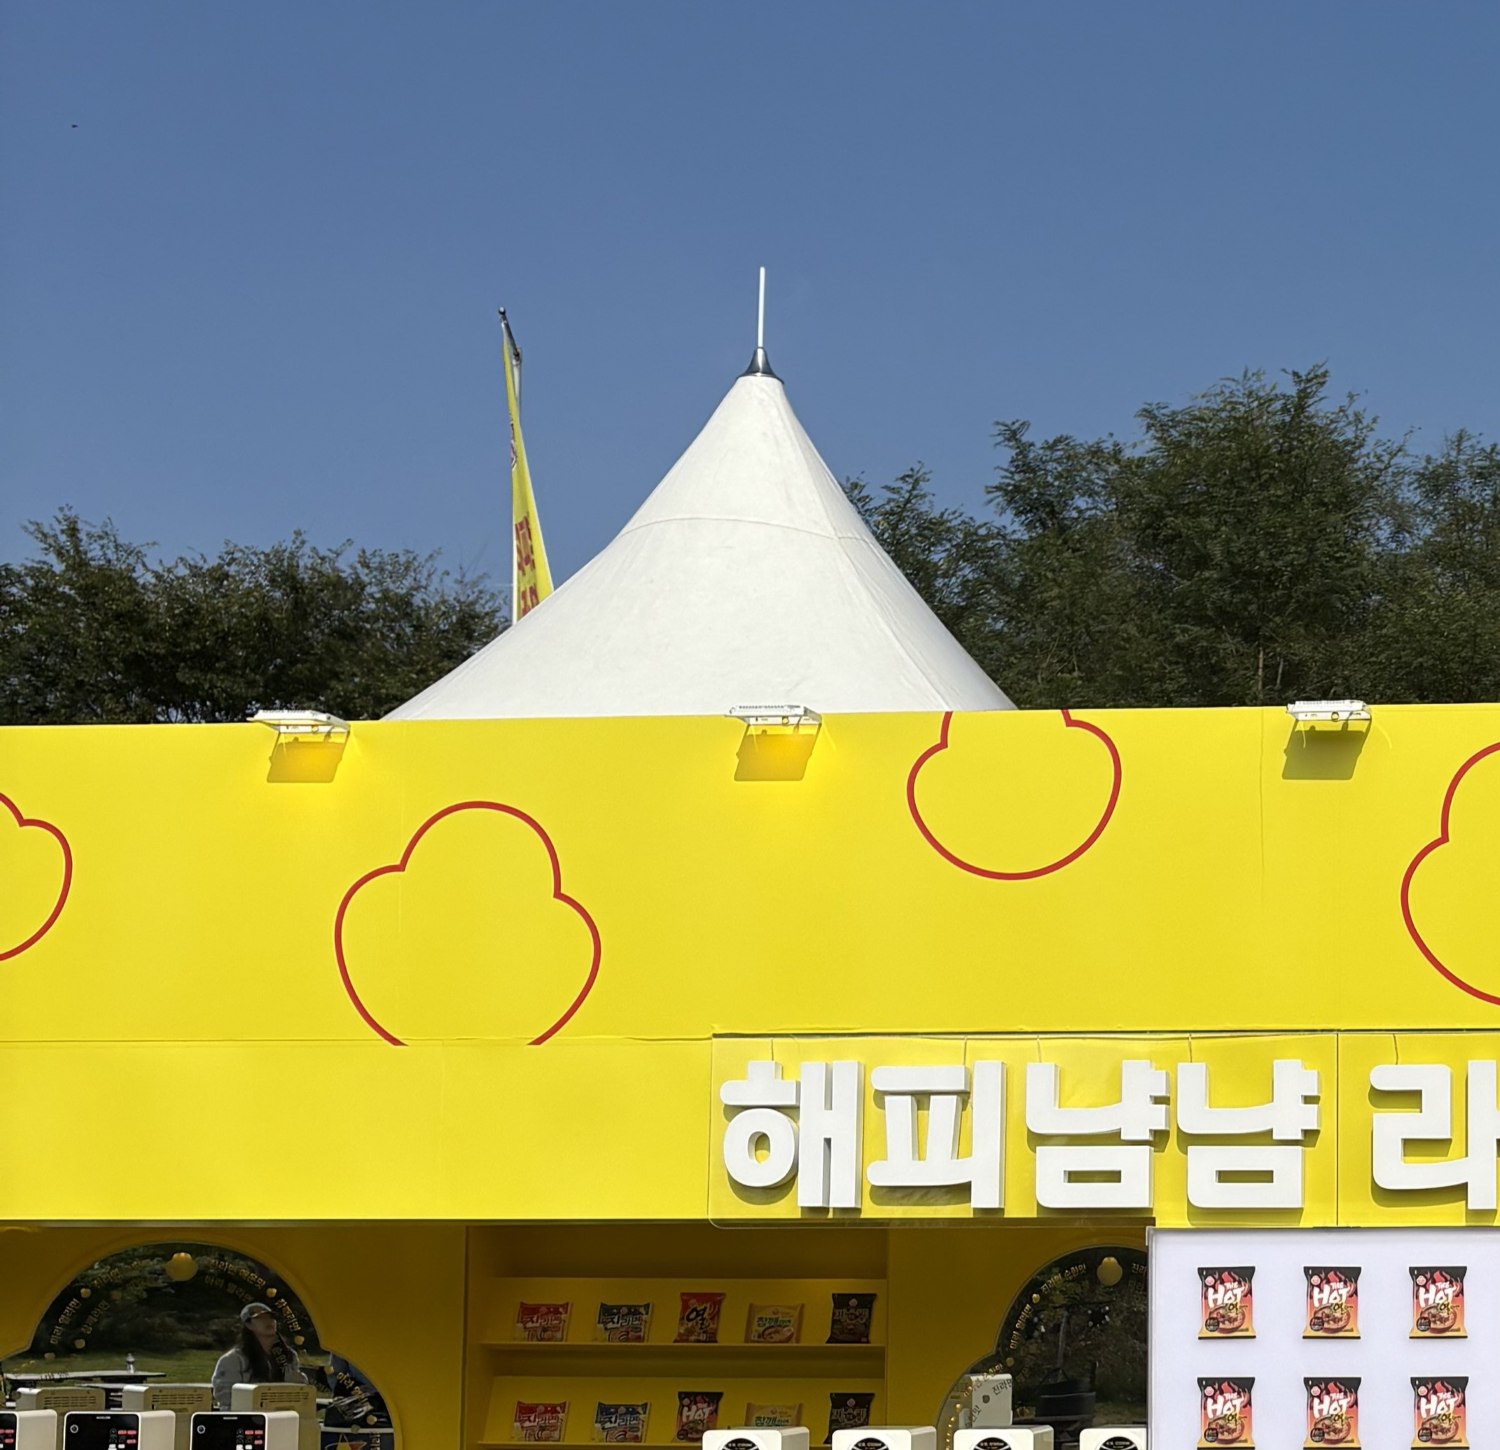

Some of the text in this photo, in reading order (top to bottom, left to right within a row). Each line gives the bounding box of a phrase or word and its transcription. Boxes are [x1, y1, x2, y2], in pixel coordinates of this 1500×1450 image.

[719, 1058, 1320, 1213] 해피냠냠
[1207, 1283, 1245, 1310] HOT
[1313, 1283, 1351, 1310] HOT
[1419, 1283, 1457, 1310] HOT
[1206, 1394, 1244, 1421] HOT
[1313, 1394, 1351, 1421] HOT
[1420, 1394, 1458, 1421] HOT
